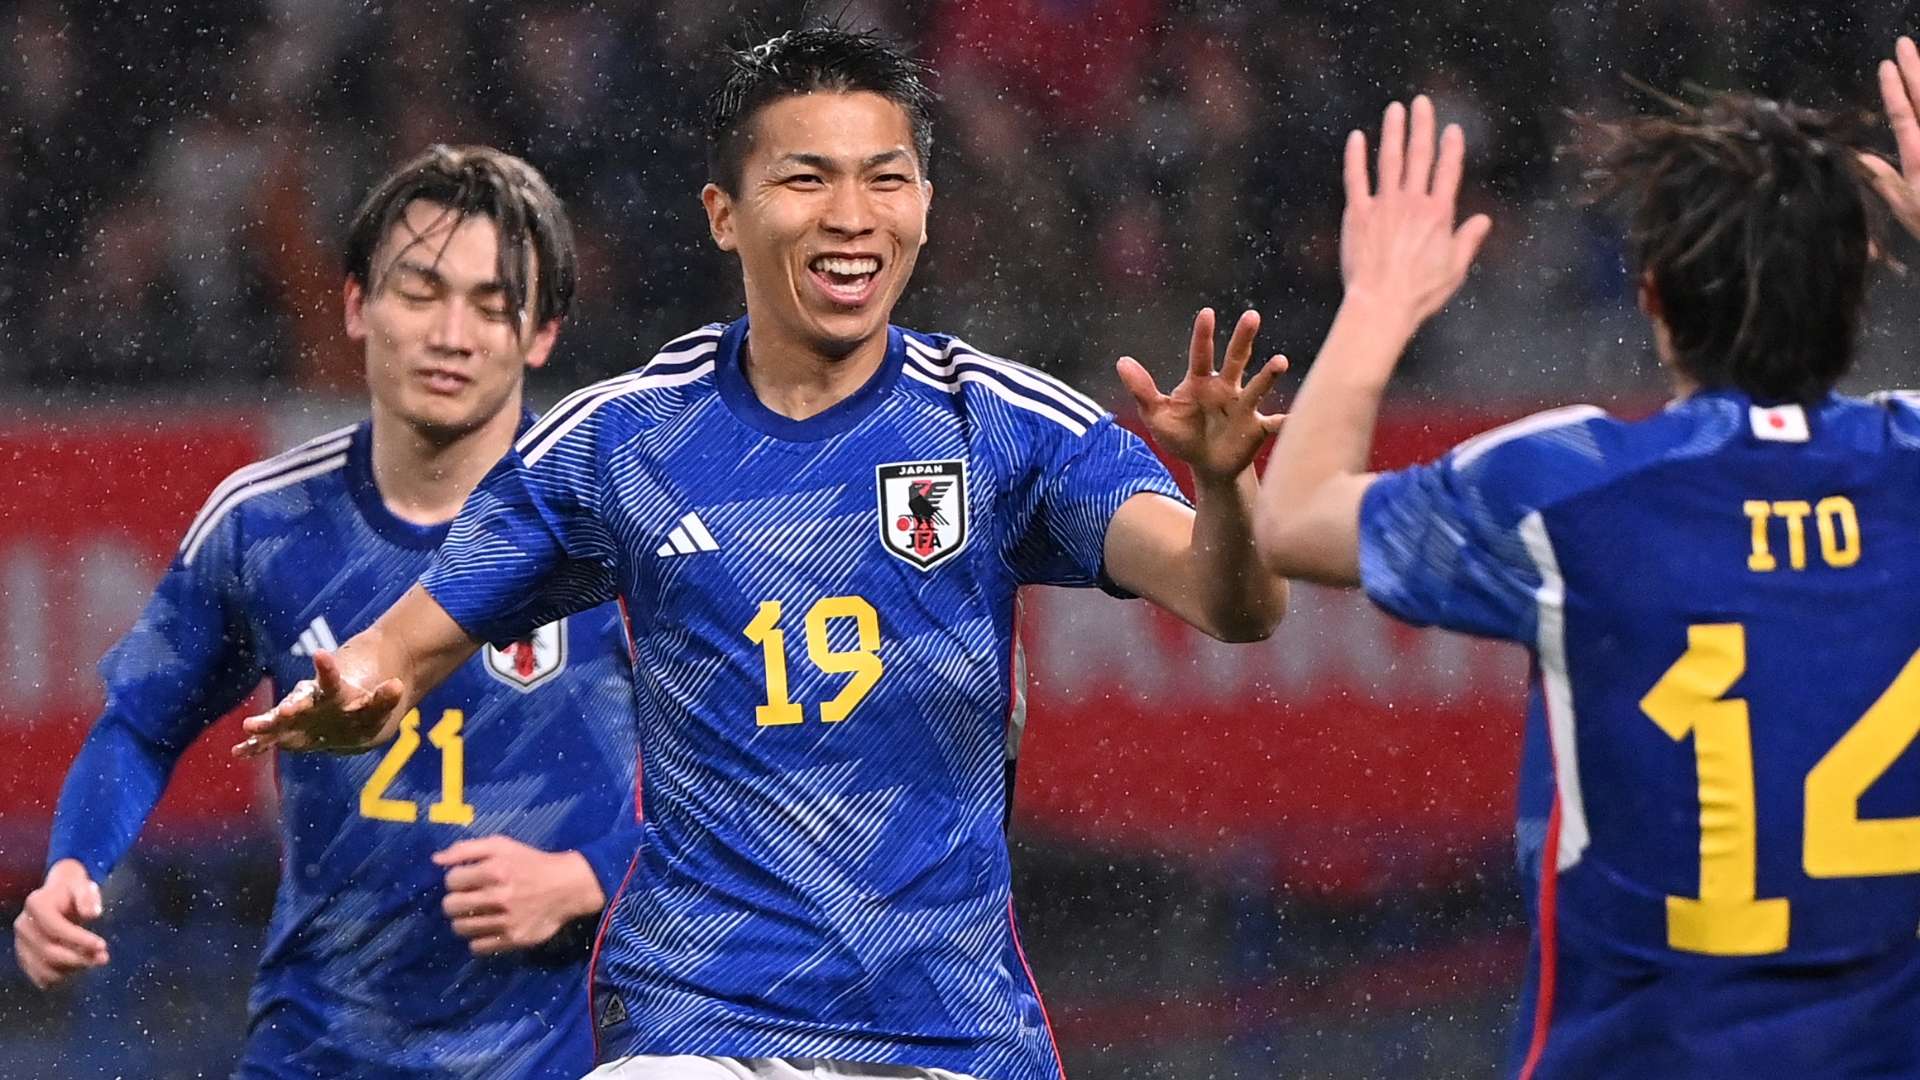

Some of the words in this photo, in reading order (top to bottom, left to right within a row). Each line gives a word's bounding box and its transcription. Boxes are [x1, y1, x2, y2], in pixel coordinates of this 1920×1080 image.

[899, 465, 943, 475] JAPAN
[906, 533, 942, 549] JFA
[1743, 496, 1860, 571] ITO
[743, 595, 884, 727] 19
[359, 706, 475, 827] 21
[1639, 623, 1920, 955] 14
